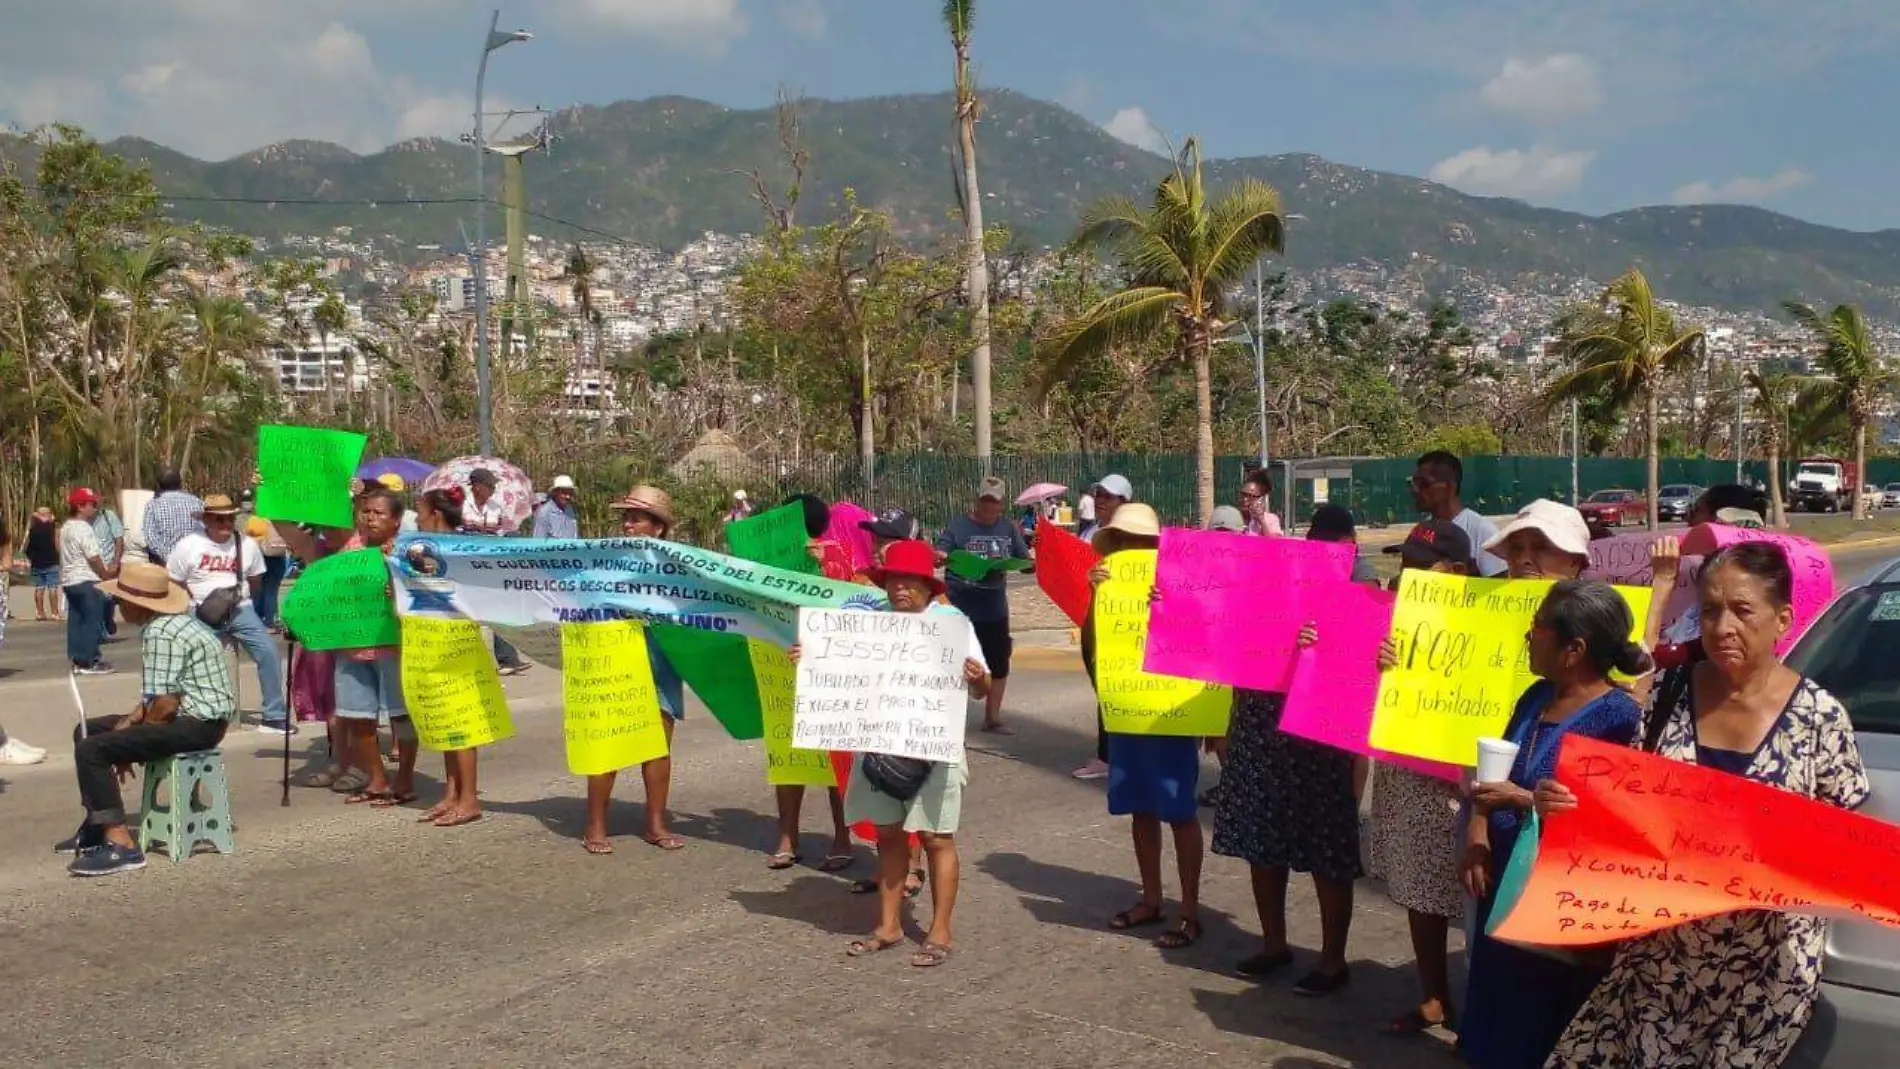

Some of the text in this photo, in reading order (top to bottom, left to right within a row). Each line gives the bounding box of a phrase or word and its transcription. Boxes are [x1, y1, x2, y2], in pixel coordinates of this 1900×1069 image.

[469, 557, 689, 577] DE GUERRERO, MUNICIPIOS
[601, 540, 719, 573] PENSIONADOS
[722, 566, 755, 583] DEL
[761, 575, 834, 600] ESTADO
[503, 577, 577, 592] PÚBLICOS
[580, 580, 757, 612] DESCENTRALIZADOS
[1404, 579, 1477, 609] Atienda
[916, 620, 941, 637] DE
[814, 636, 930, 664] ISSSPEG
[1487, 641, 1506, 668] de
[802, 667, 871, 689] JUBILADO
[795, 697, 850, 715] EXIGEN
[922, 696, 948, 712] DE
[1412, 682, 1502, 719] jubilados
